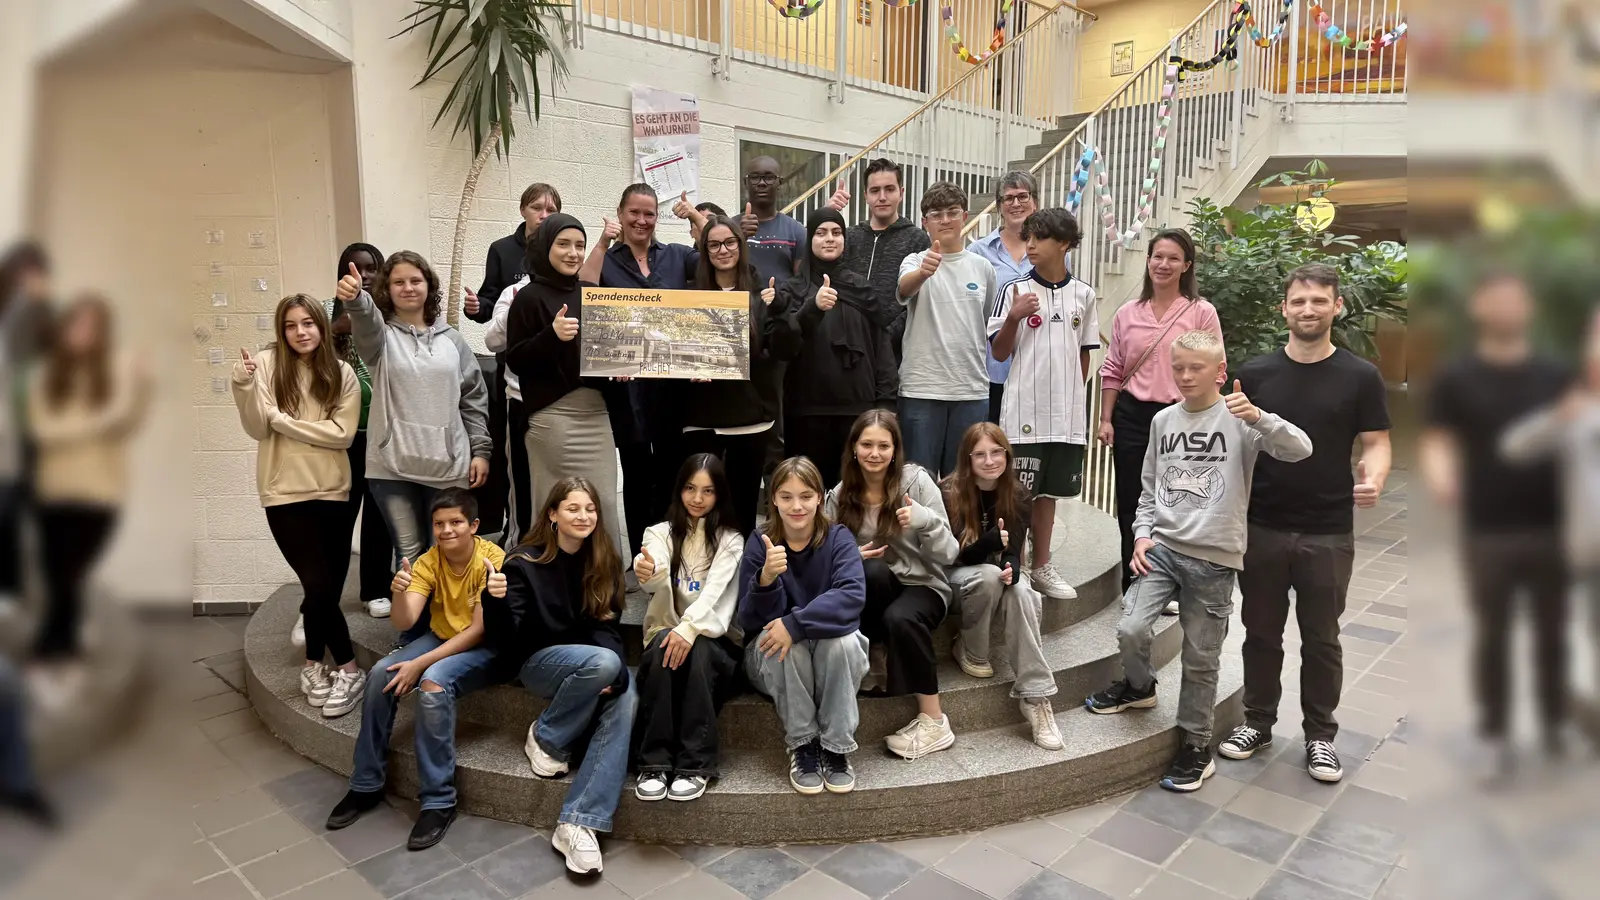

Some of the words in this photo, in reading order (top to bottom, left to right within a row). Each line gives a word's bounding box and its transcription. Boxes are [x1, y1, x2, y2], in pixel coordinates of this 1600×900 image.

[635, 114, 645, 124] ES
[646, 113, 667, 124] GEHT
[669, 113, 681, 123] AN
[683, 112, 698, 122] DIE
[642, 124, 692, 136] WAHLURNE!
[585, 291, 662, 303] Spendenscheck
[1160, 431, 1227, 455] NASA
[1012, 457, 1029, 470] NEW
[1019, 471, 1035, 490] 92
